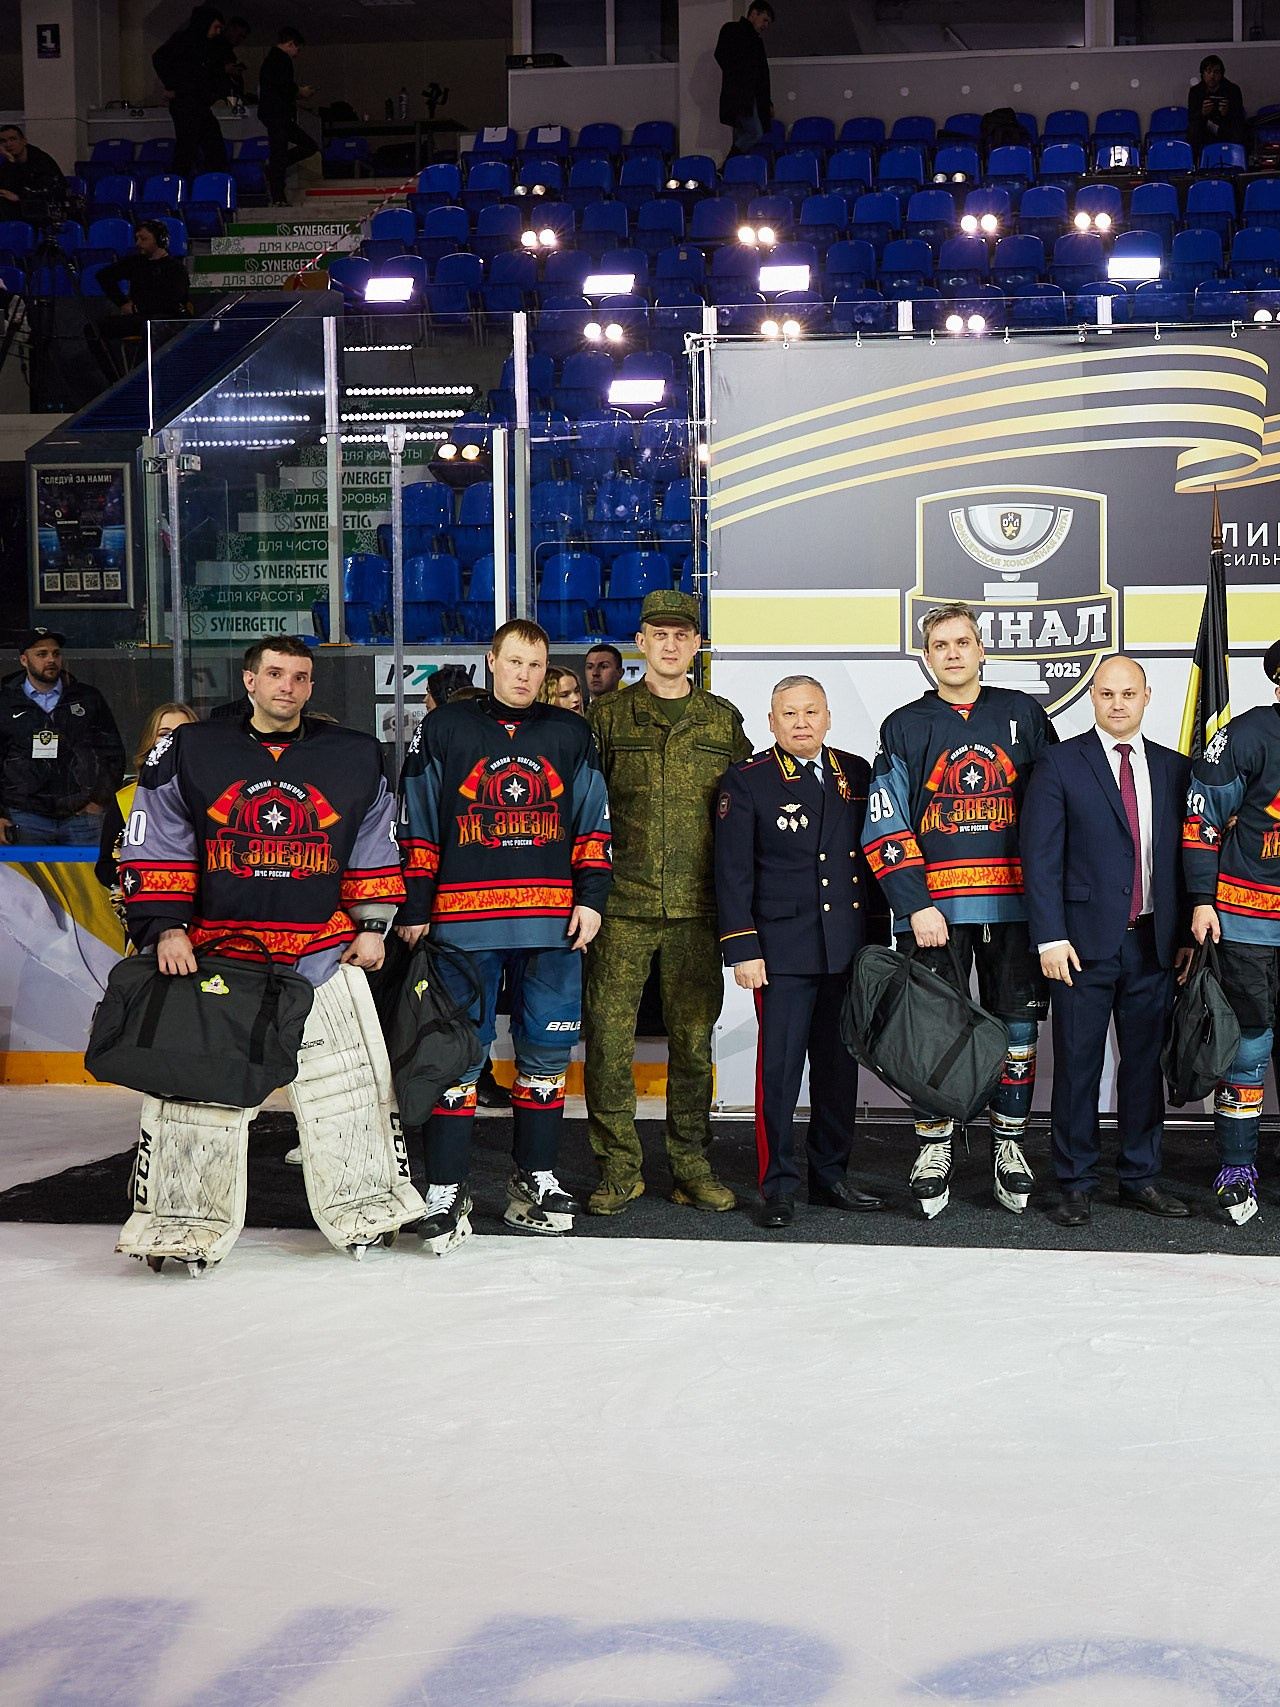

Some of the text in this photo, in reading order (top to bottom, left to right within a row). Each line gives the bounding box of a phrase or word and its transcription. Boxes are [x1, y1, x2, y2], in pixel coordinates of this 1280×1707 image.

[42, 30, 56, 49] 1
[293, 223, 351, 236] SYNERGETIC
[258, 242, 283, 254] ДЛЯ
[261, 258, 320, 272] SYNERGETIC
[222, 275, 249, 286] ДЛЯ
[76, 475, 86, 484] ЗА
[87, 474, 112, 484] НАМИ!
[295, 494, 319, 506] ДЛЯ
[294, 514, 372, 530] SYNEETIC
[257, 540, 283, 553] ДЛЯ
[253, 564, 328, 579] SYNERGETIC
[217, 591, 242, 604] ДЛЯ
[210, 616, 288, 632] SYNERGETIC
[1044, 661, 1081, 679] 2025
[869, 787, 895, 823] 99
[952, 796, 1016, 826] ЗВЕЗДА
[457, 810, 561, 847] ХК ЗВЕЗДА
[205, 838, 333, 874] ХК ЗВЕЗДА
[268, 868, 291, 878] РОССИИ
[134, 1127, 154, 1207] CCM
